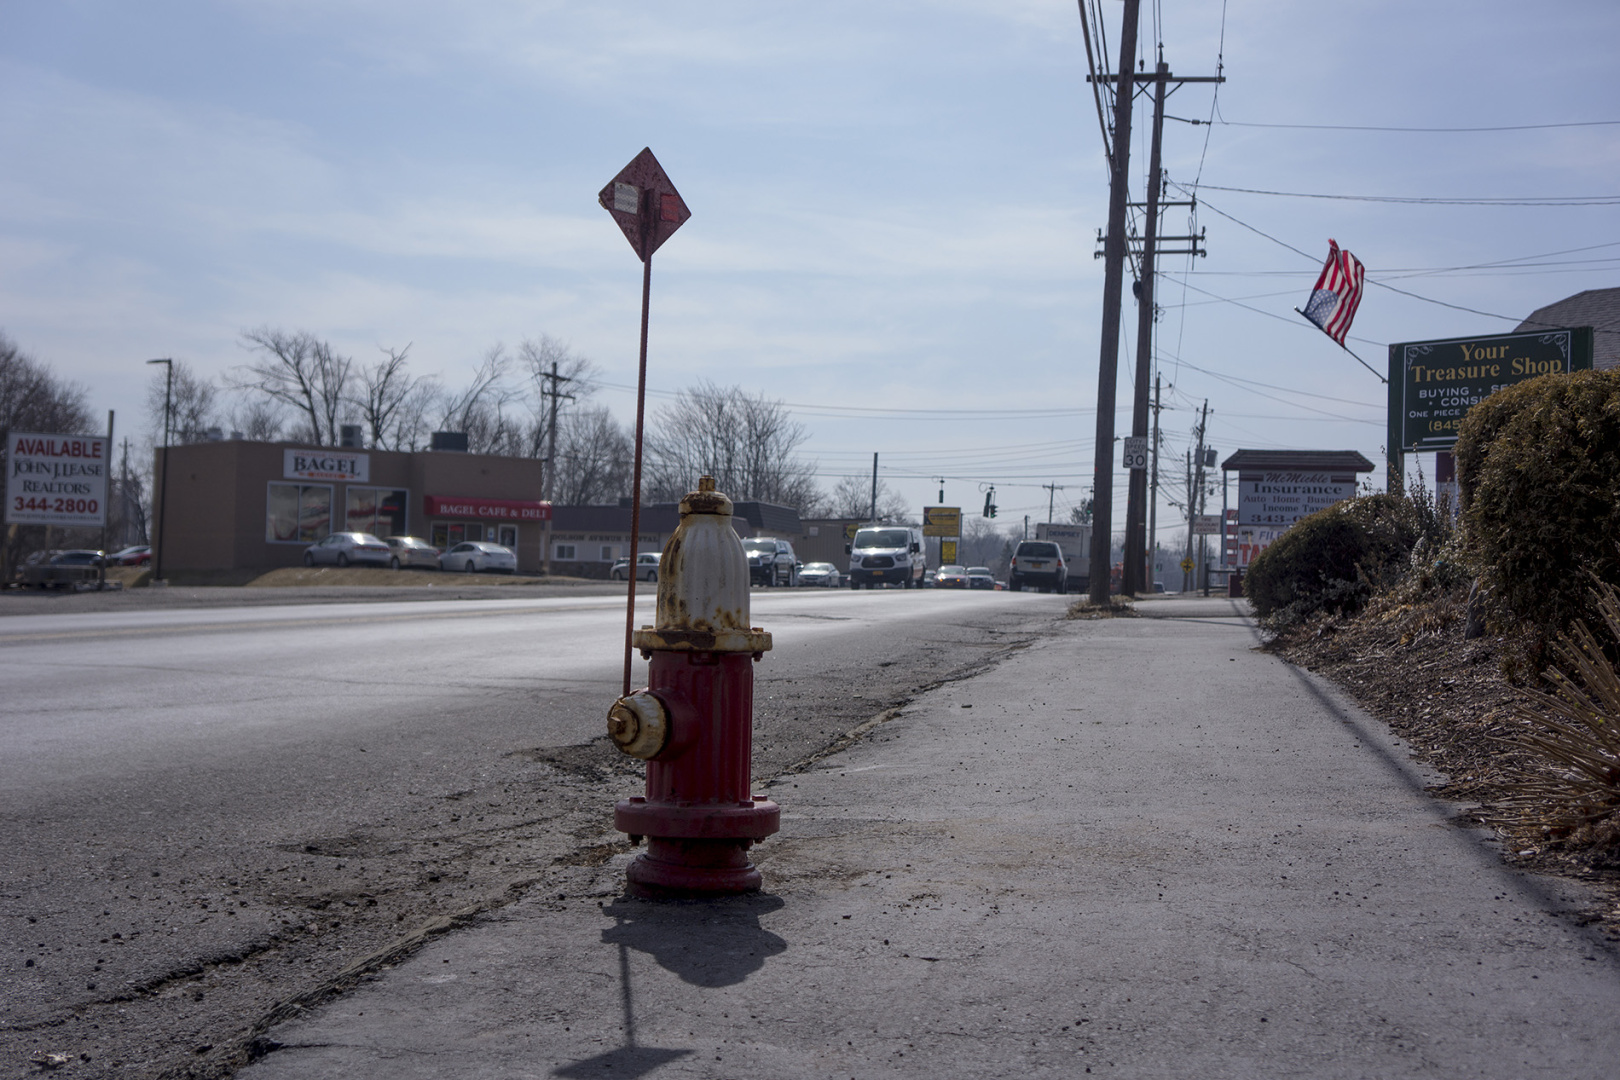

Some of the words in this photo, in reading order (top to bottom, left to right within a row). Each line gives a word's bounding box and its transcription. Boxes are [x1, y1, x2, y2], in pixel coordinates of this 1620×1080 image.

[1460, 344, 1510, 361] Your
[1411, 363, 1501, 383] Treasure
[1511, 356, 1562, 375] Shop
[1419, 386, 1470, 398] BUYING
[1409, 410, 1428, 418] ONE
[1433, 408, 1460, 417] PIECE
[14, 438, 102, 458] AVAILABLE
[293, 456, 360, 476] BAGEL
[1125, 454, 1145, 466] 30
[12, 459, 51, 477] JOHN
[62, 463, 103, 477] LEASE
[1265, 472, 1329, 483] McMickle
[22, 480, 91, 494] REALTORS
[1254, 483, 1342, 494] Insurance
[14, 496, 98, 514] 344-2800
[1243, 495, 1266, 503] Auto
[1273, 495, 1300, 503] Home
[440, 504, 475, 514] BAGEL
[478, 506, 507, 517] CAFE
[521, 508, 546, 518] DELI
[1263, 504, 1299, 512] Income
[1239, 544, 1268, 565] TA
